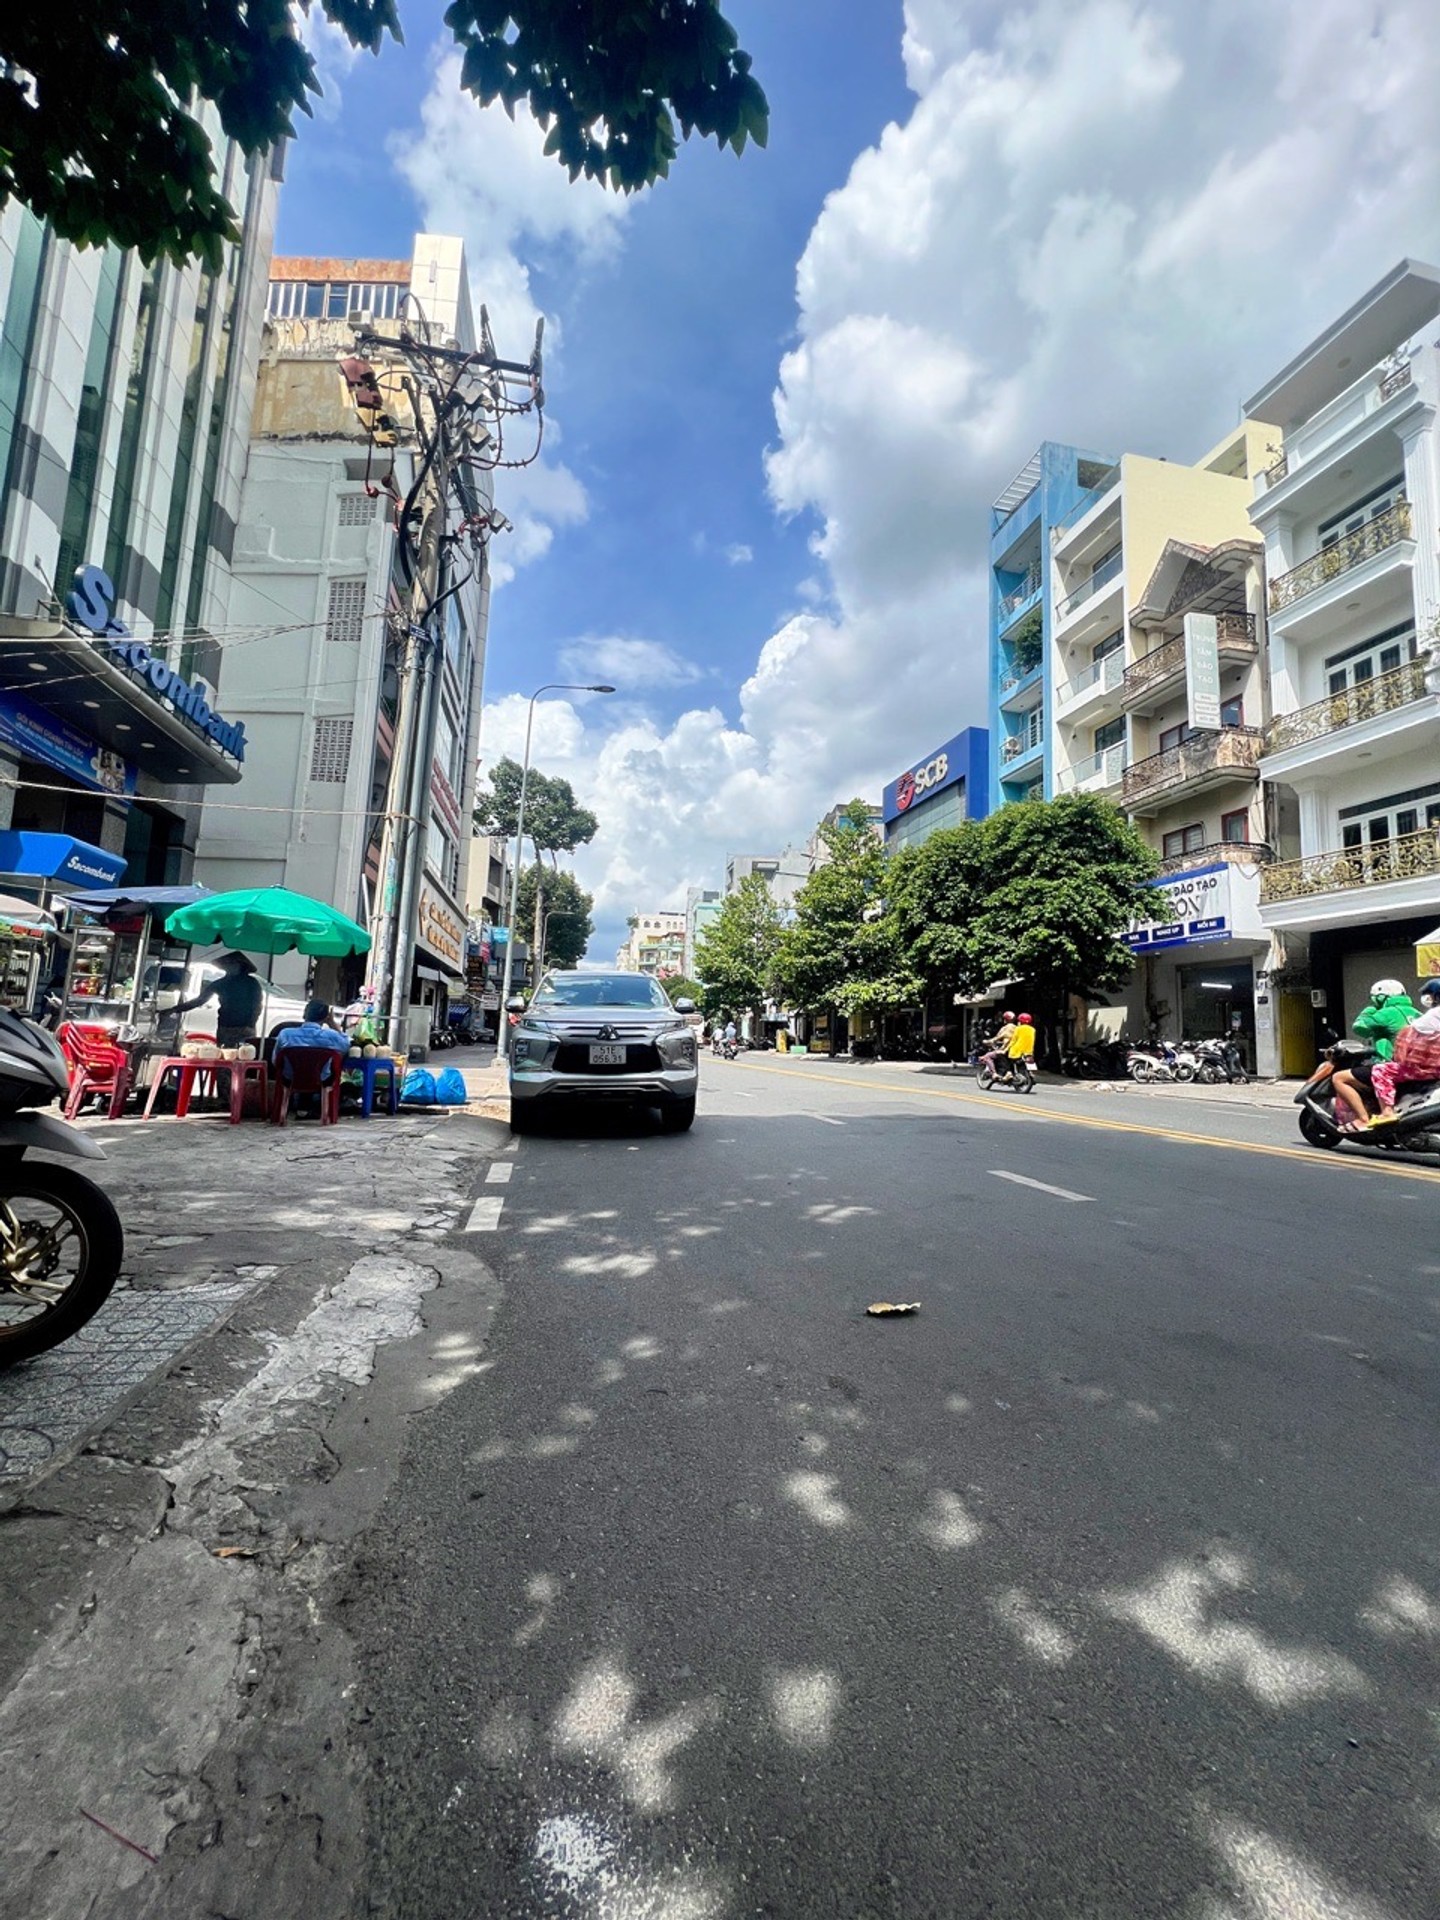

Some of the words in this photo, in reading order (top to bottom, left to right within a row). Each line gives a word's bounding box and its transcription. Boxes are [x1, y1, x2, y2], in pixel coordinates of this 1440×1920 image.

[67, 563, 248, 762] Sacombank
[915, 753, 948, 795] SCB
[67, 856, 116, 882] Sacombank
[1174, 883, 1194, 896] ĐÀO
[1195, 877, 1217, 892] TẠO
